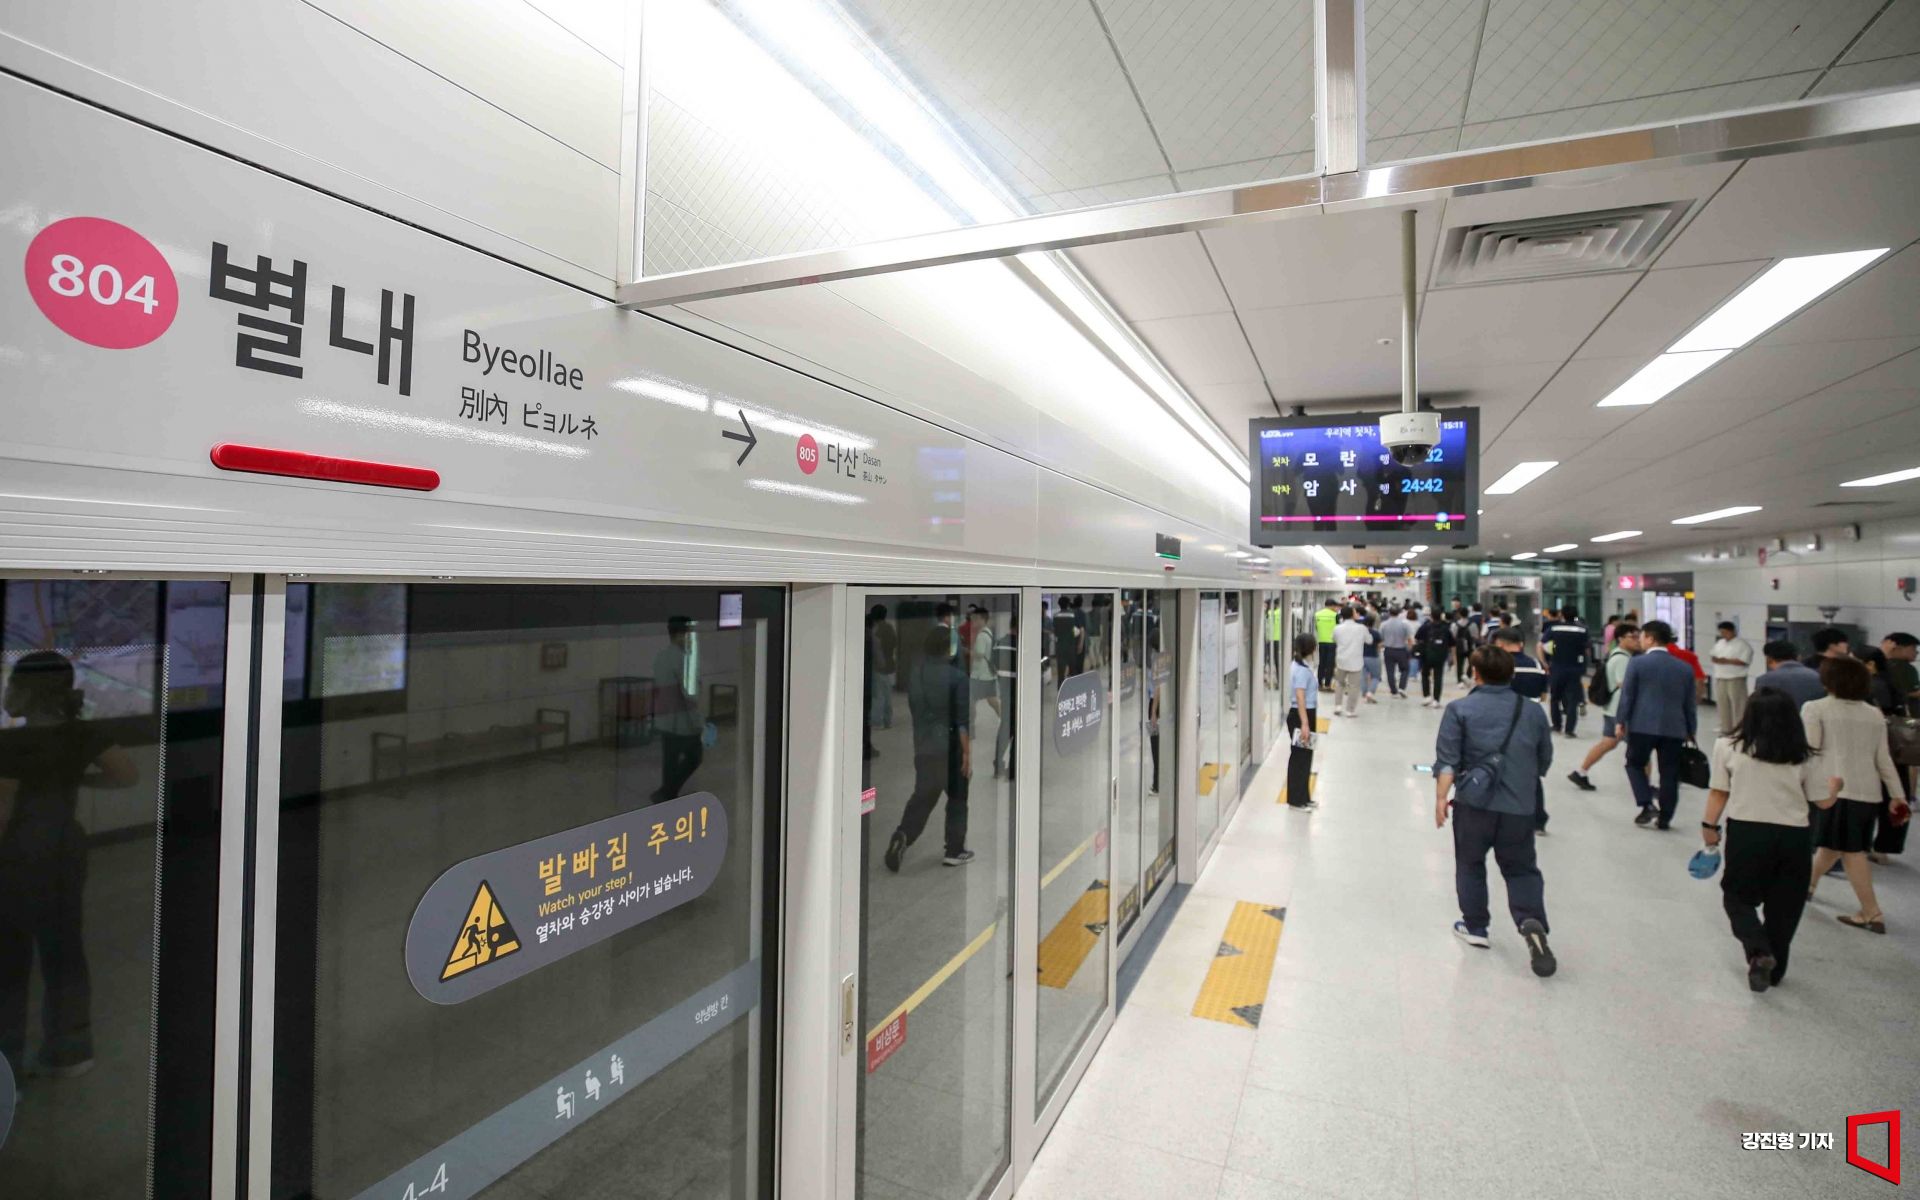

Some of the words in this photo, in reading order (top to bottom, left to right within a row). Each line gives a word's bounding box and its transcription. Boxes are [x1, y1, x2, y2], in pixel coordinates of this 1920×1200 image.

[48, 253, 159, 315] 804
[209, 241, 416, 397] 별내
[462, 328, 585, 391] Byeollae
[523, 402, 599, 441] ピョルネ
[799, 446, 816, 462] 805
[827, 442, 858, 478] 다산
[863, 452, 881, 468] Dasan
[1272, 456, 1290, 467] 첫차
[1271, 484, 1291, 495] 막차
[1401, 477, 1444, 494] 24:42
[535, 912, 575, 944] 열차와
[579, 896, 615, 926] 승강장
[618, 882, 651, 907] 사이가
[653, 865, 694, 896] 넓습니다.
[538, 894, 575, 917] Watch
[578, 885, 602, 905] your
[695, 1000, 719, 1025] 약냉방
[875, 1019, 901, 1052] 비상문
